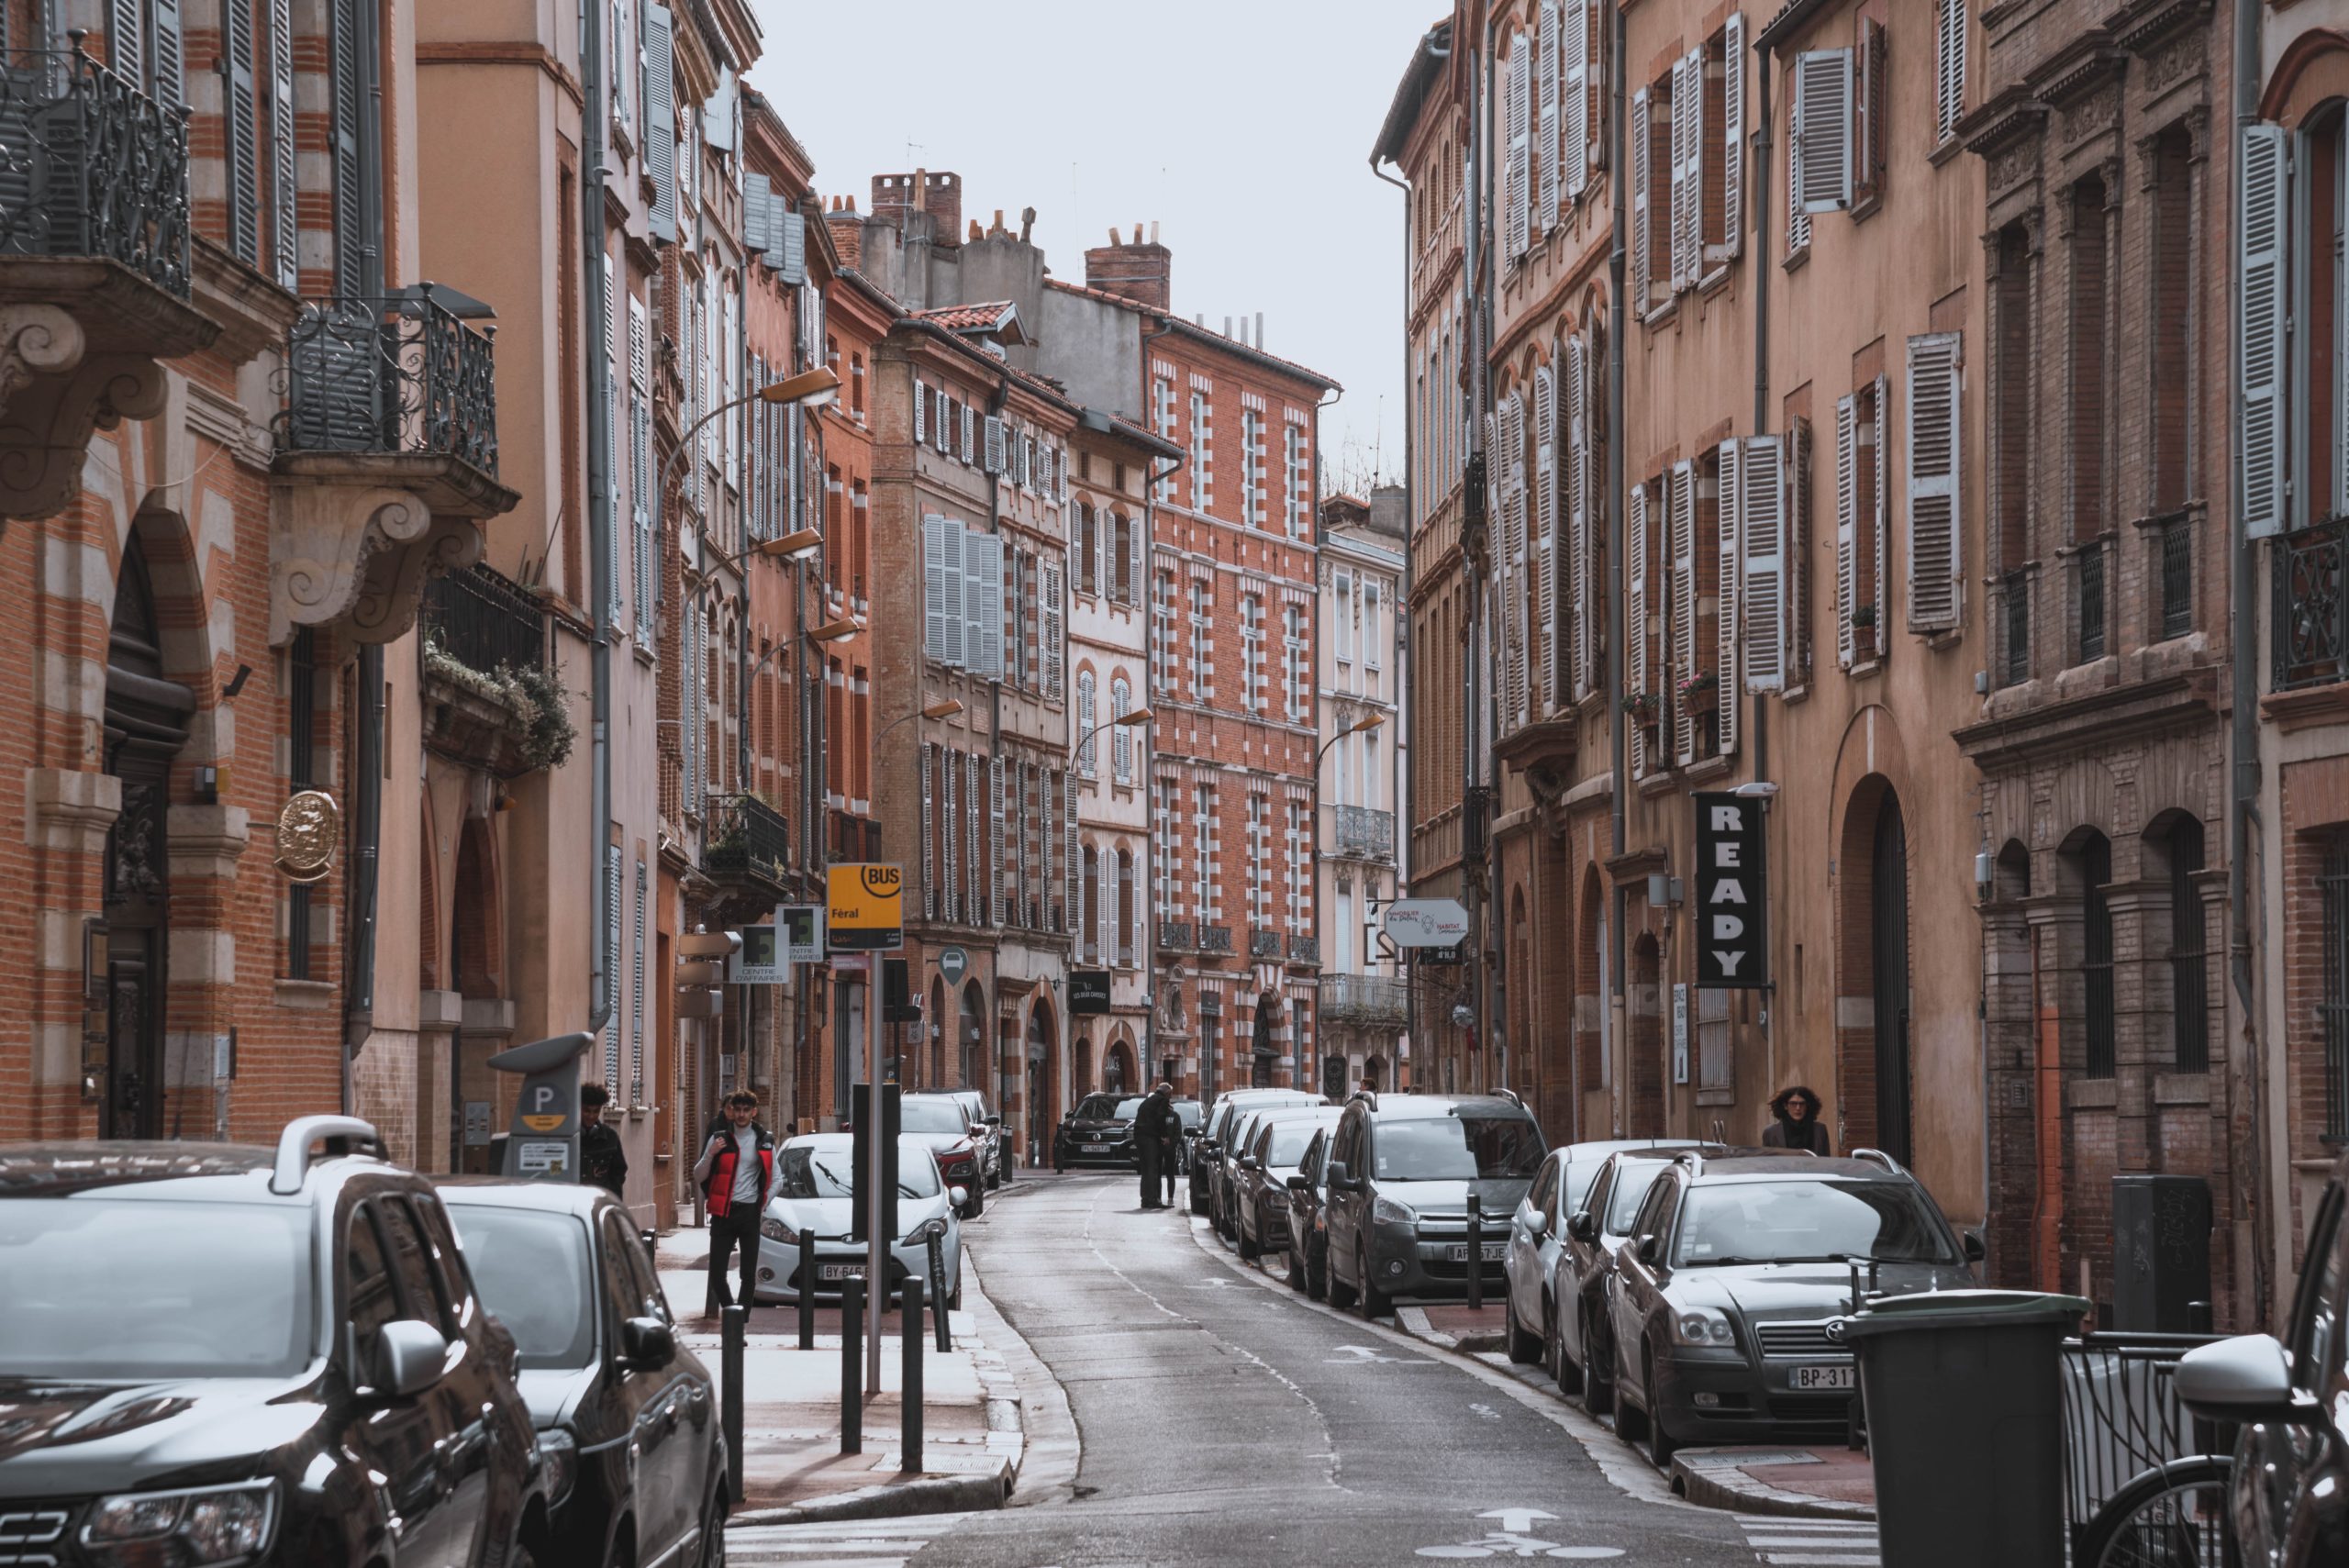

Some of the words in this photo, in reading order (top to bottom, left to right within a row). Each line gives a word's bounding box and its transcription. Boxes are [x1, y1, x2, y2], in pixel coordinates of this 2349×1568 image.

[868, 868, 899, 884] BUS
[1709, 806, 1748, 976] READY
[831, 907, 859, 918] Féral
[536, 1086, 554, 1112] P
[826, 1266, 869, 1278] BY-646-
[1801, 1369, 1854, 1386] BP-31
